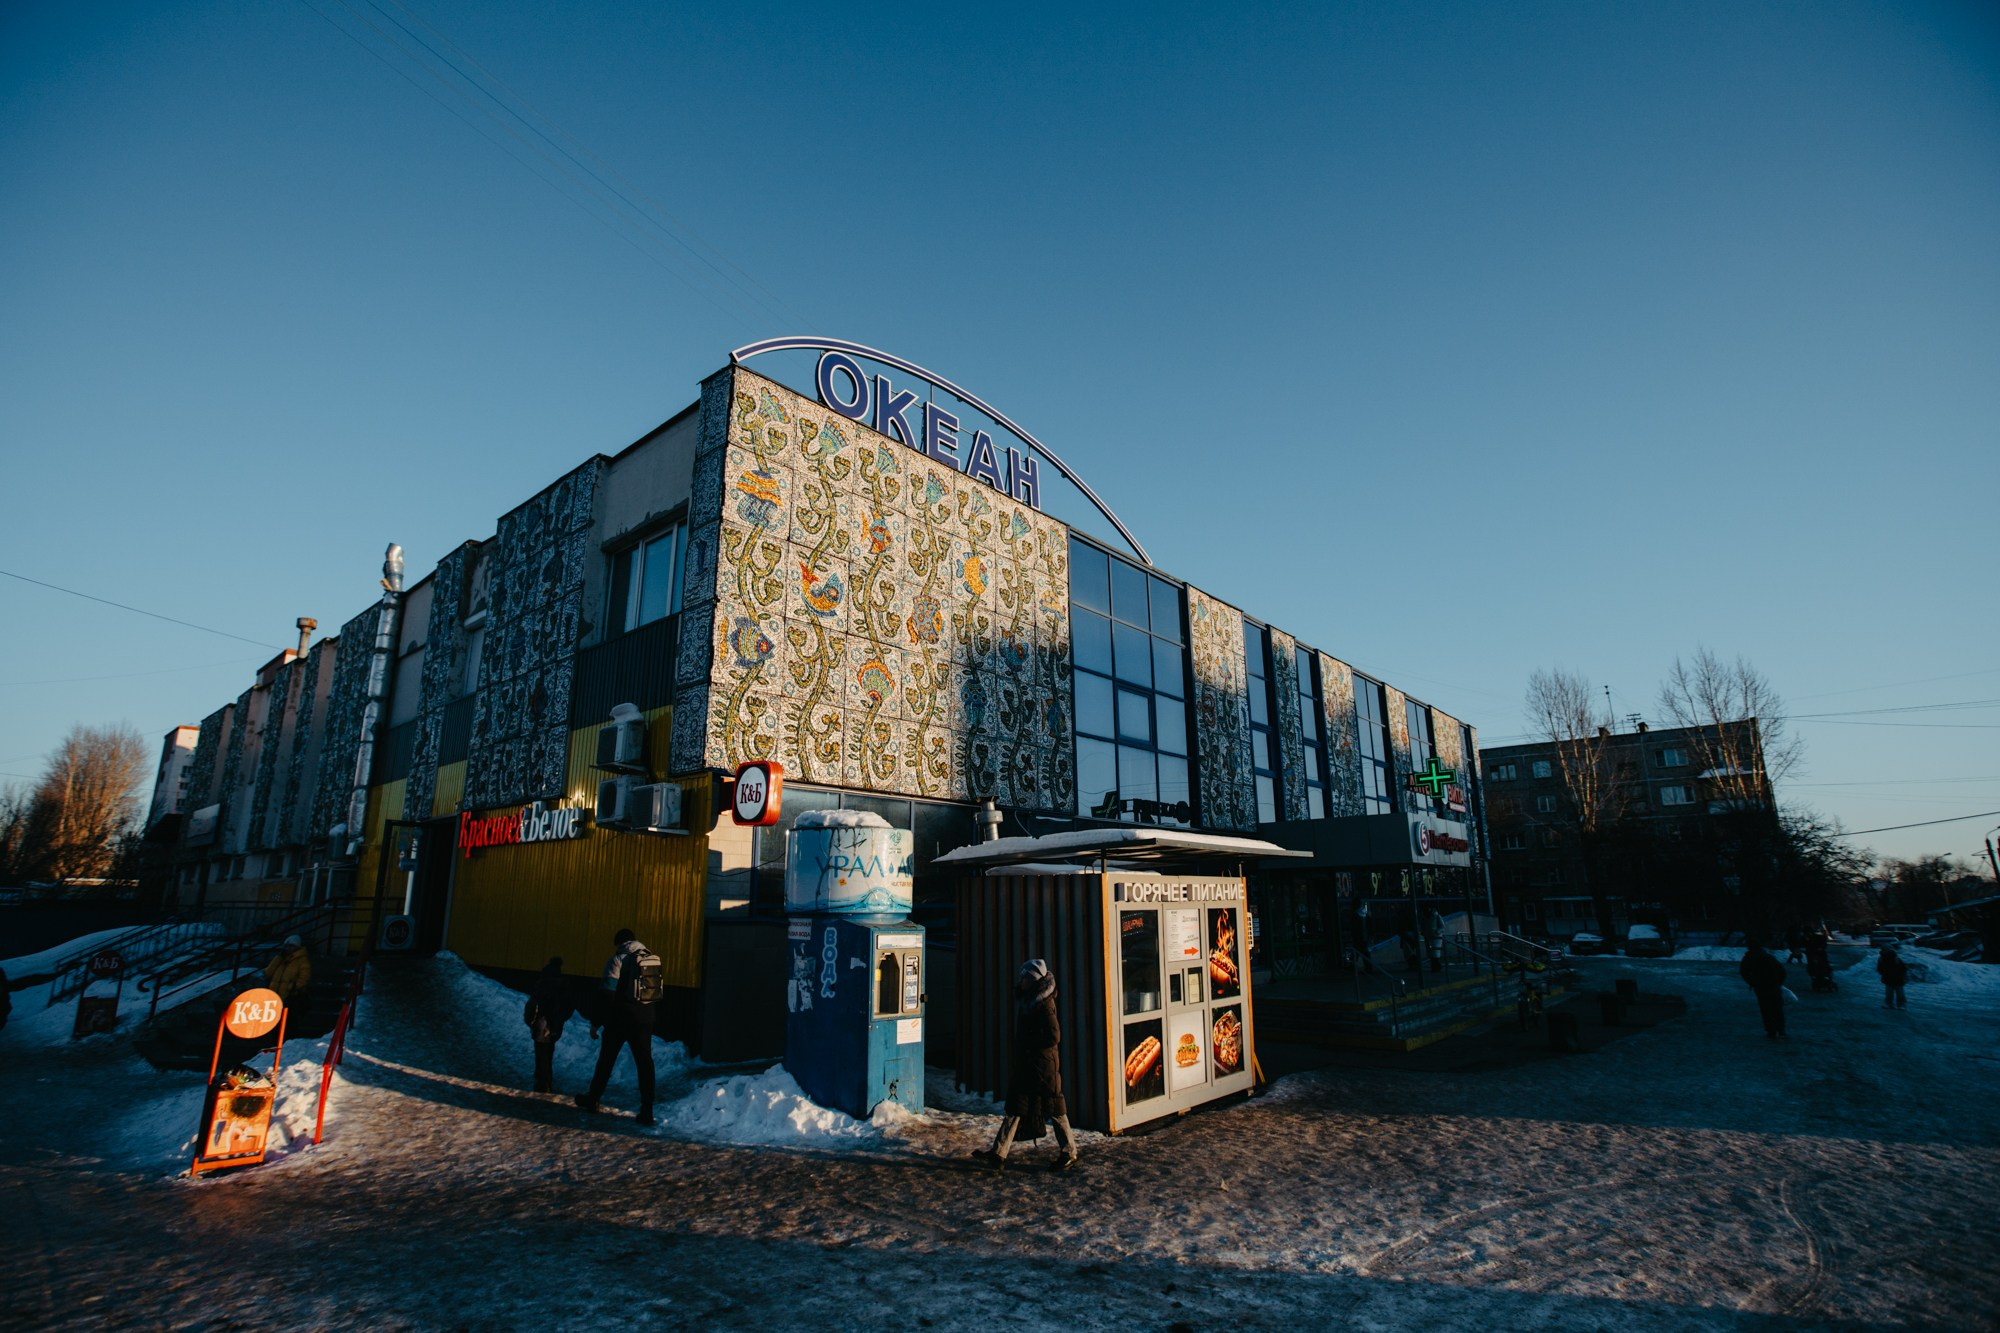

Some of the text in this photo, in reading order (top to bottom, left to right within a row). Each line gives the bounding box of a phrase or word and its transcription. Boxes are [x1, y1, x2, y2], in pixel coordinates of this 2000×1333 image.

[817, 351, 1041, 511] ОКЕАН
[739, 782, 762, 805] К&Б
[815, 855, 885, 878] УРАЛ
[1124, 882, 1245, 902] ГОРЯЧЕЕ ПИТАНИЕ
[92, 956, 120, 970] К&Б
[821, 926, 838, 998] ВОДА
[231, 1000, 278, 1025] К&Б
